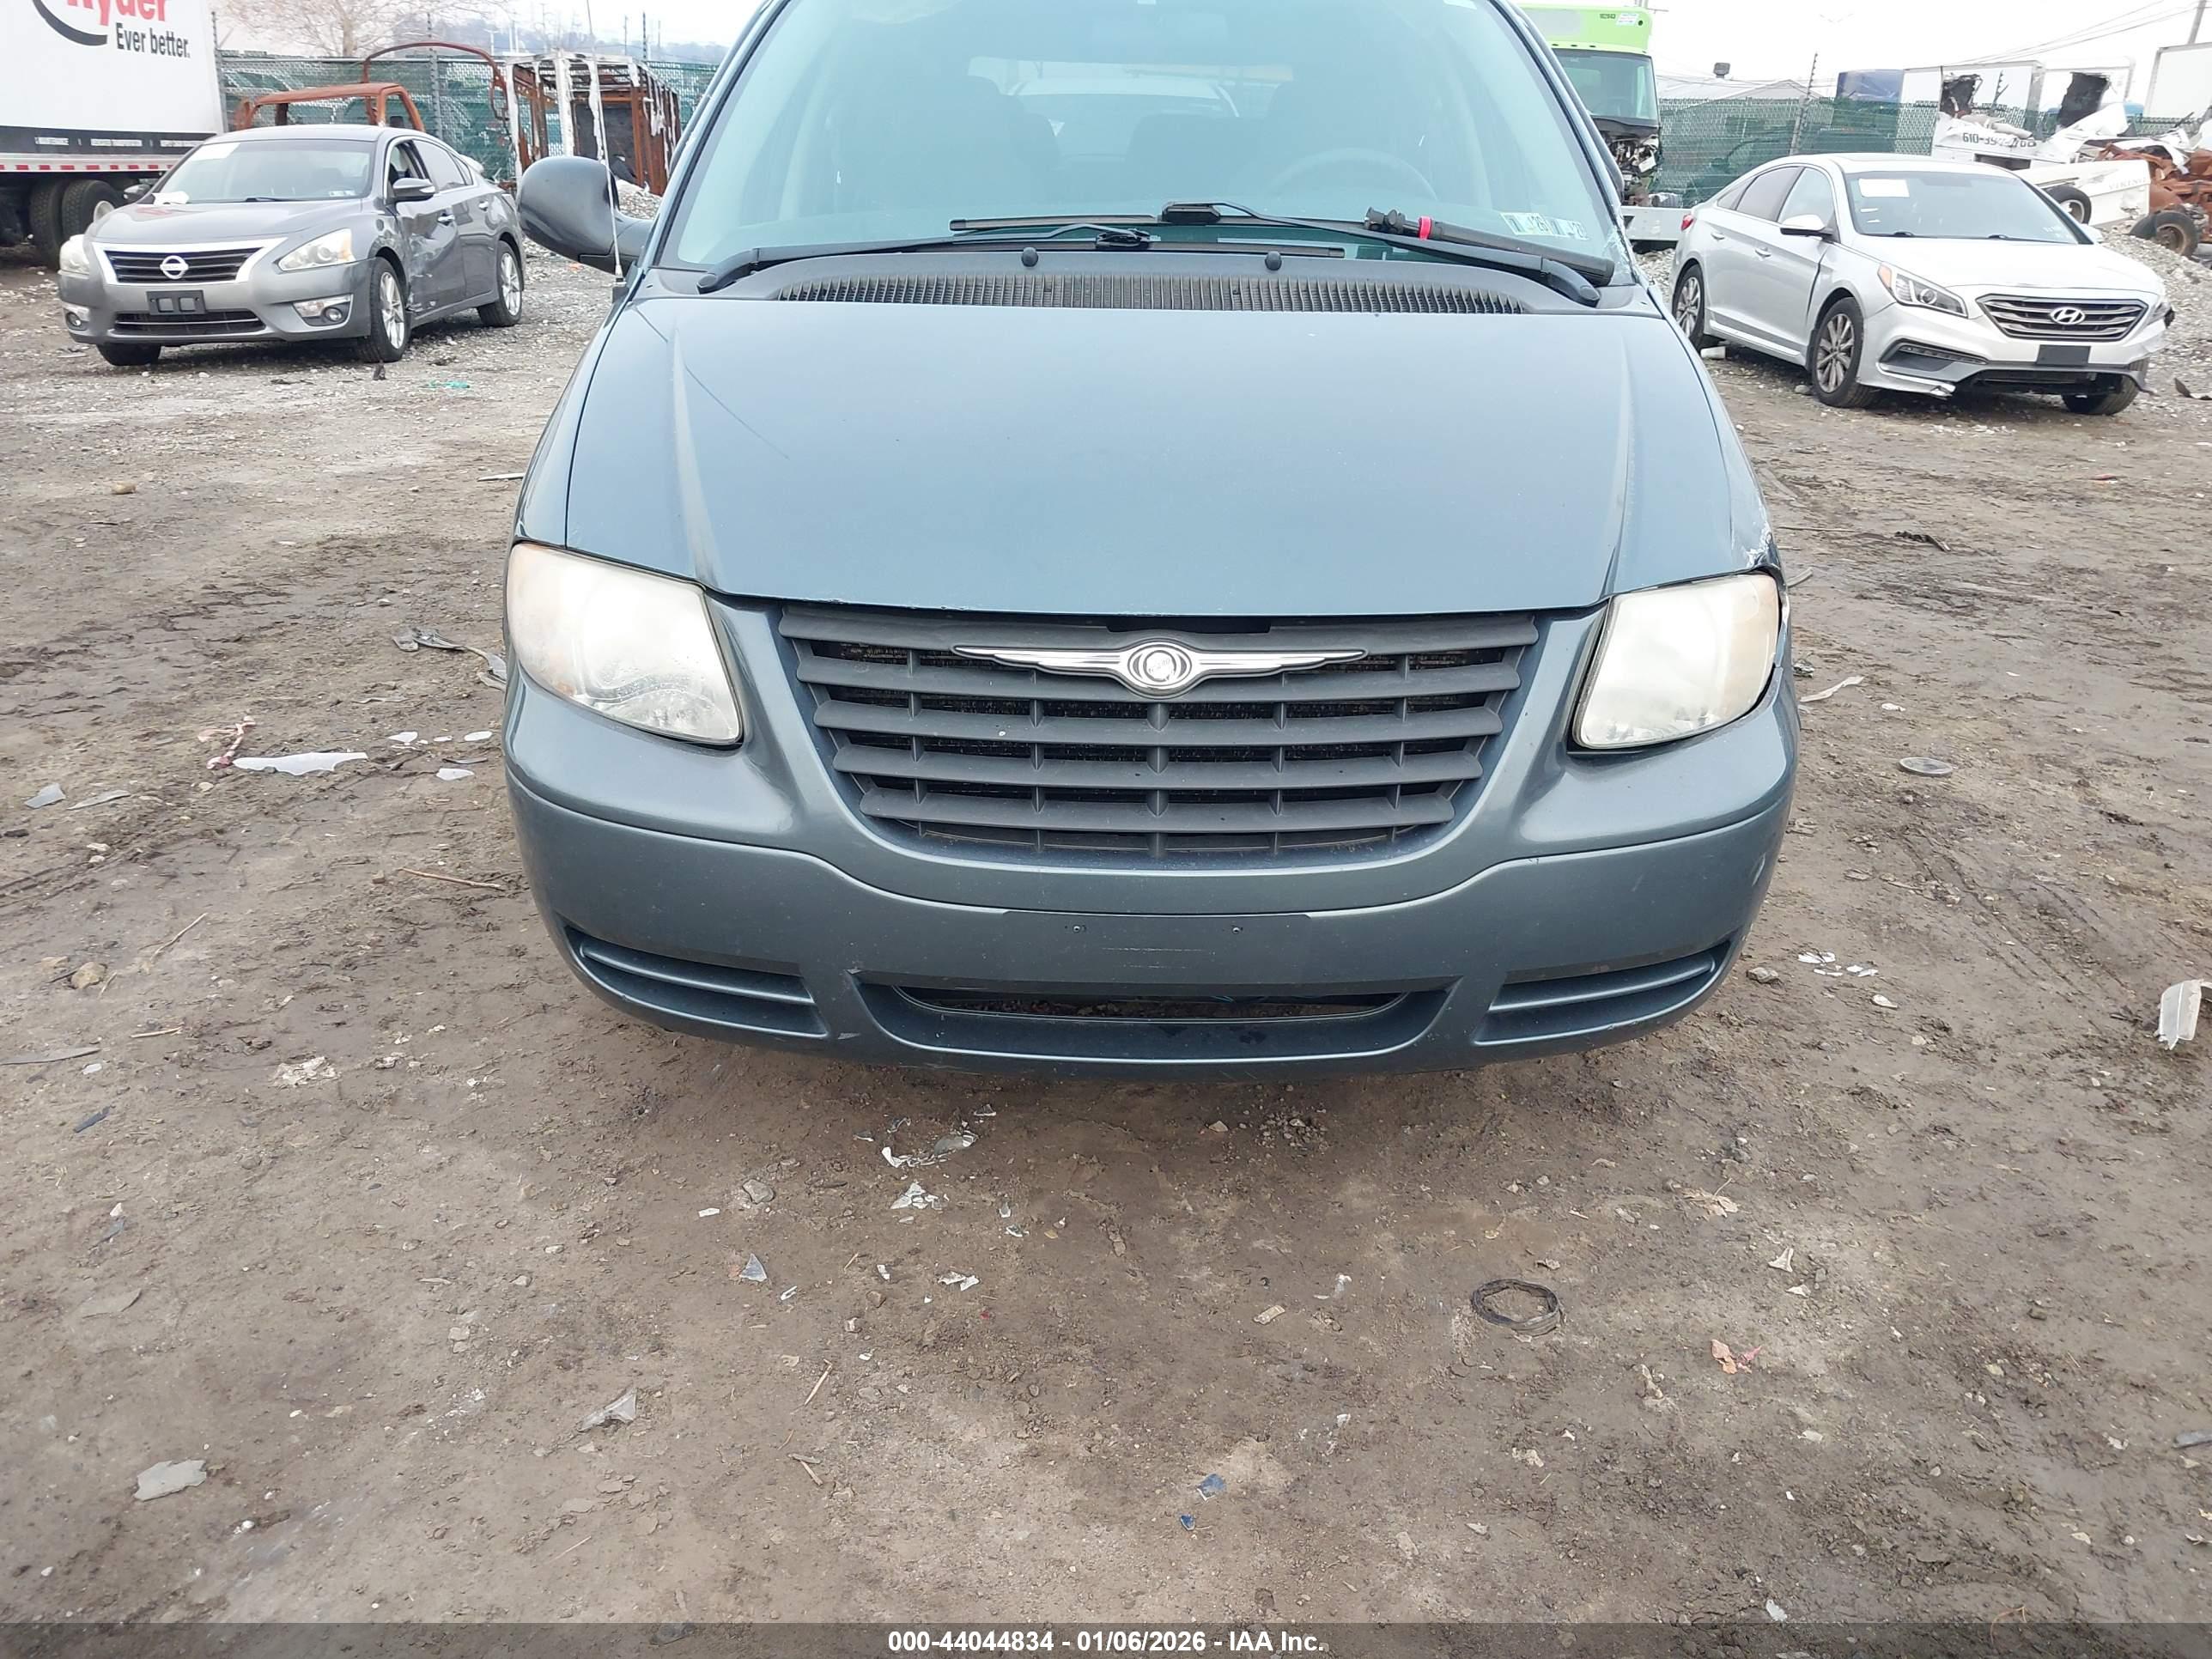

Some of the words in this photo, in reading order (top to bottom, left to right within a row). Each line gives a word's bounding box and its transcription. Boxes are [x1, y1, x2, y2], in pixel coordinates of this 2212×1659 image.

[67, 0, 167, 27] yder
[115, 22, 146, 53] Ever
[149, 27, 191, 58] better.
